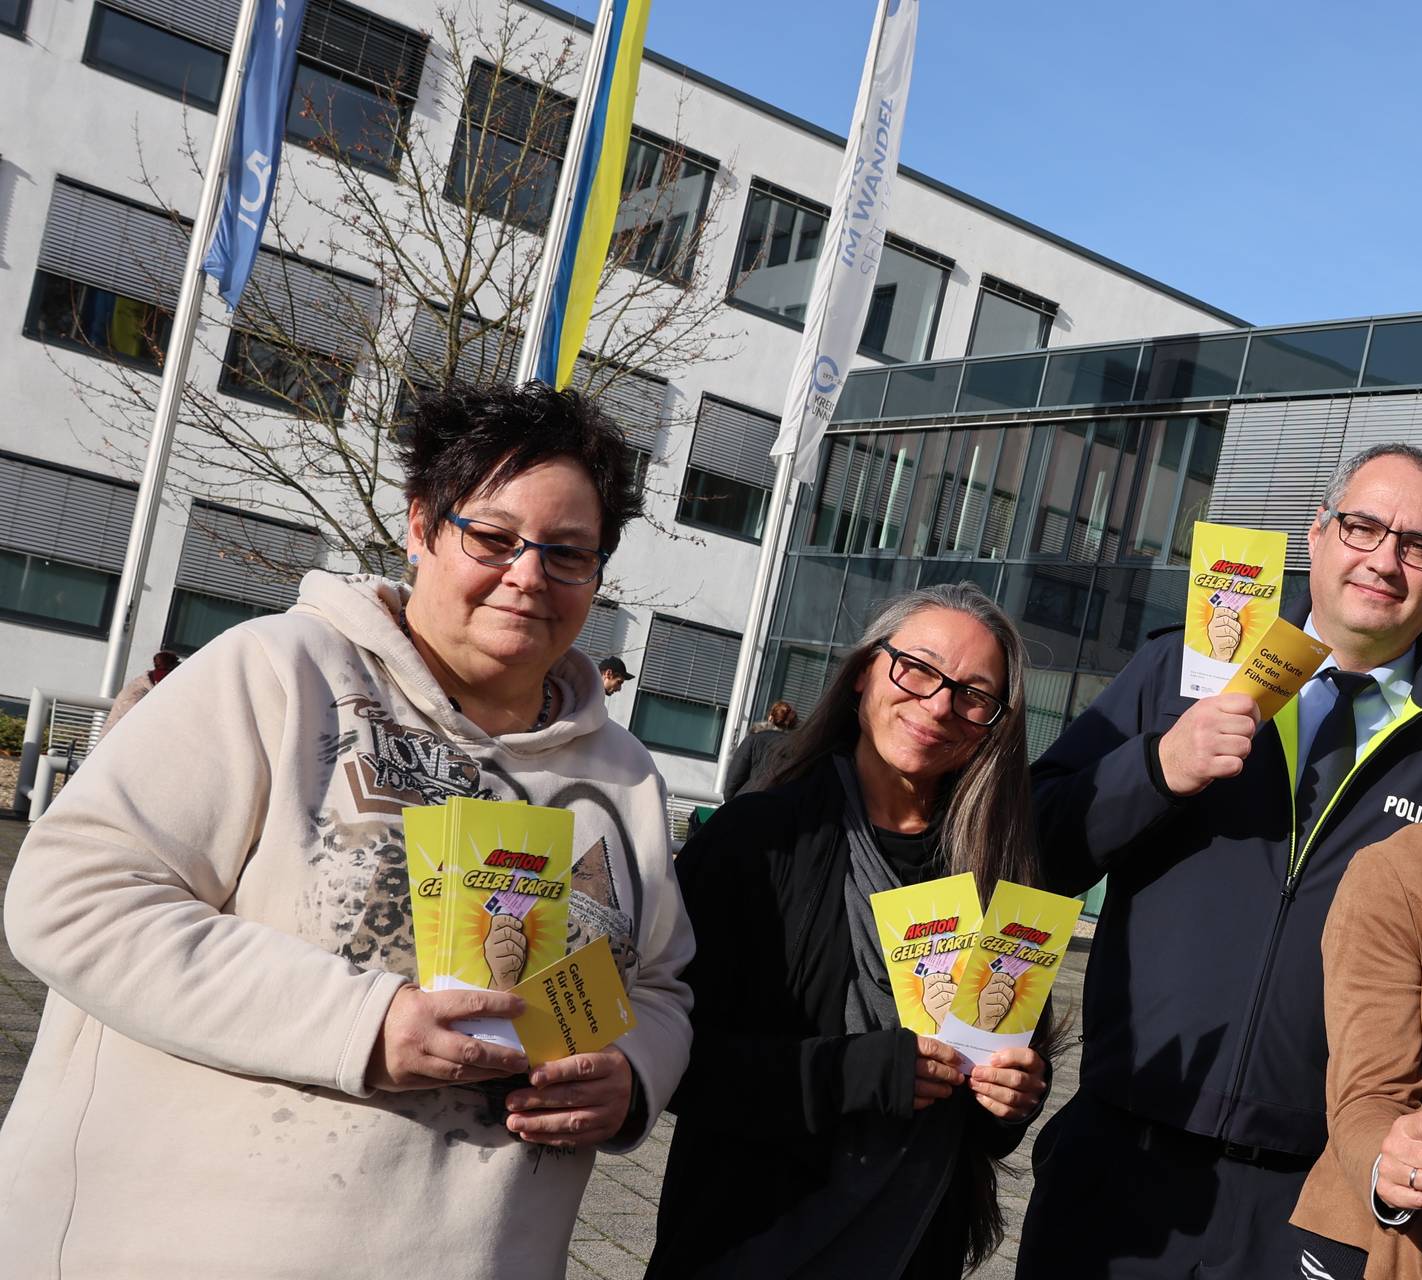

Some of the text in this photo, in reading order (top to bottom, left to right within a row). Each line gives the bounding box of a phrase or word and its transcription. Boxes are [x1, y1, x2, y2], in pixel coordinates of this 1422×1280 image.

[841, 226, 862, 268] IM
[852, 99, 893, 221] WANDEL
[1210, 559, 1263, 578] AKTION
[1194, 574, 1276, 599] GELBE KARTE
[1252, 657, 1280, 681] für den
[1259, 648, 1304, 679] Gelbe Karte
[1244, 667, 1293, 699] Führerschein!
[484, 849, 549, 874] AKTION
[463, 870, 564, 899] GELBE KARTE
[904, 916, 959, 940] AKTION
[1000, 922, 1053, 946] AKTION
[891, 932, 979, 963] GELBE KARTE
[979, 936, 1058, 967] GELBE KARTE
[556, 970, 577, 1014] für den
[569, 963, 599, 1034] Gelbe Karte
